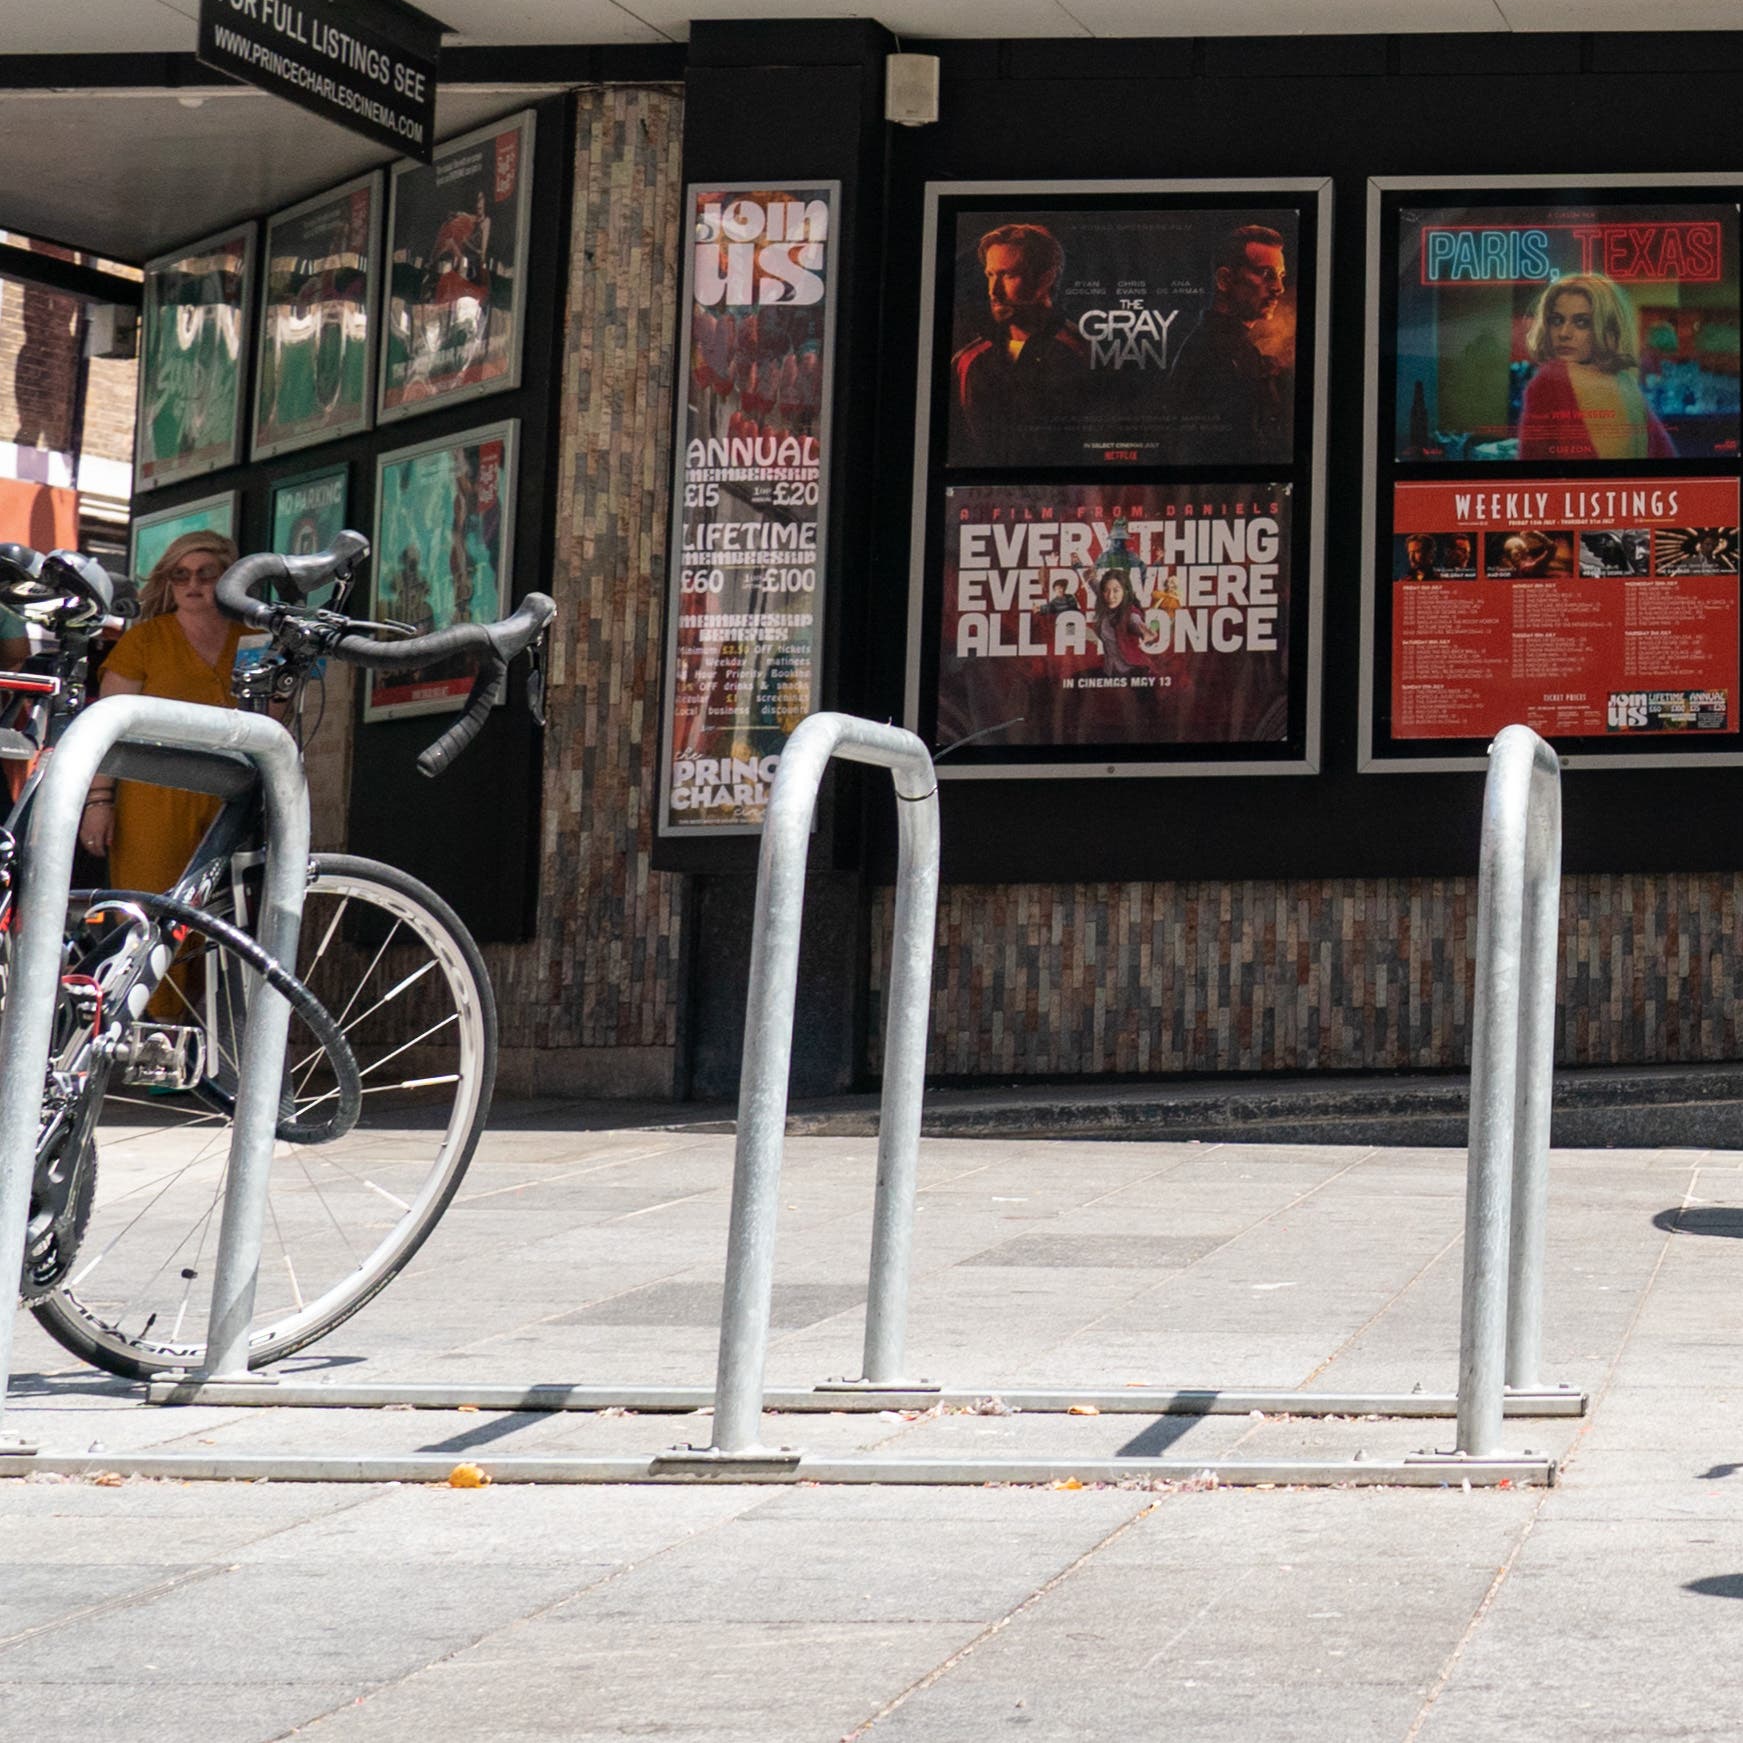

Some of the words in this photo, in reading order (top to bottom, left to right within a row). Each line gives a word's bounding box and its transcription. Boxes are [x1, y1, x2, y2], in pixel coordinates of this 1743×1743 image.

[312, 19, 390, 85] LISTINGS
[394, 63, 426, 103] SEE
[214, 24, 423, 143] WWW.PRINCECHARLESCINEMA.COM
[1428, 230, 1560, 284] PARIS,
[1572, 227, 1716, 278] TEXAS
[1119, 298, 1145, 310] THE
[1078, 308, 1180, 342] GRAY
[1089, 338, 1168, 371] MAN
[686, 436, 820, 468] ANNUAL
[686, 467, 820, 482] MEMBERSHIP
[684, 483, 720, 507] £15
[772, 482, 819, 506] £20
[1455, 492, 1549, 520] WEEKLY
[1564, 490, 1679, 518] LISTINGS
[959, 508, 969, 520] A
[992, 507, 1054, 520] FILM
[1076, 505, 1144, 519] FROM
[1166, 502, 1280, 517] DANIELS
[683, 521, 818, 551] LIFETIME
[681, 550, 817, 565] MEMBERSHIP
[680, 569, 725, 594] £60
[762, 568, 816, 592] £100
[956, 610, 1048, 658] ALL
[1139, 606, 1279, 655] ONCE
[1062, 678, 1074, 689] IN
[1077, 677, 1128, 689] CINEMAS
[1130, 677, 1156, 688] MAY
[1158, 676, 1172, 688] 13
[672, 754, 782, 787] PRINC
[670, 782, 770, 811] CHARL
